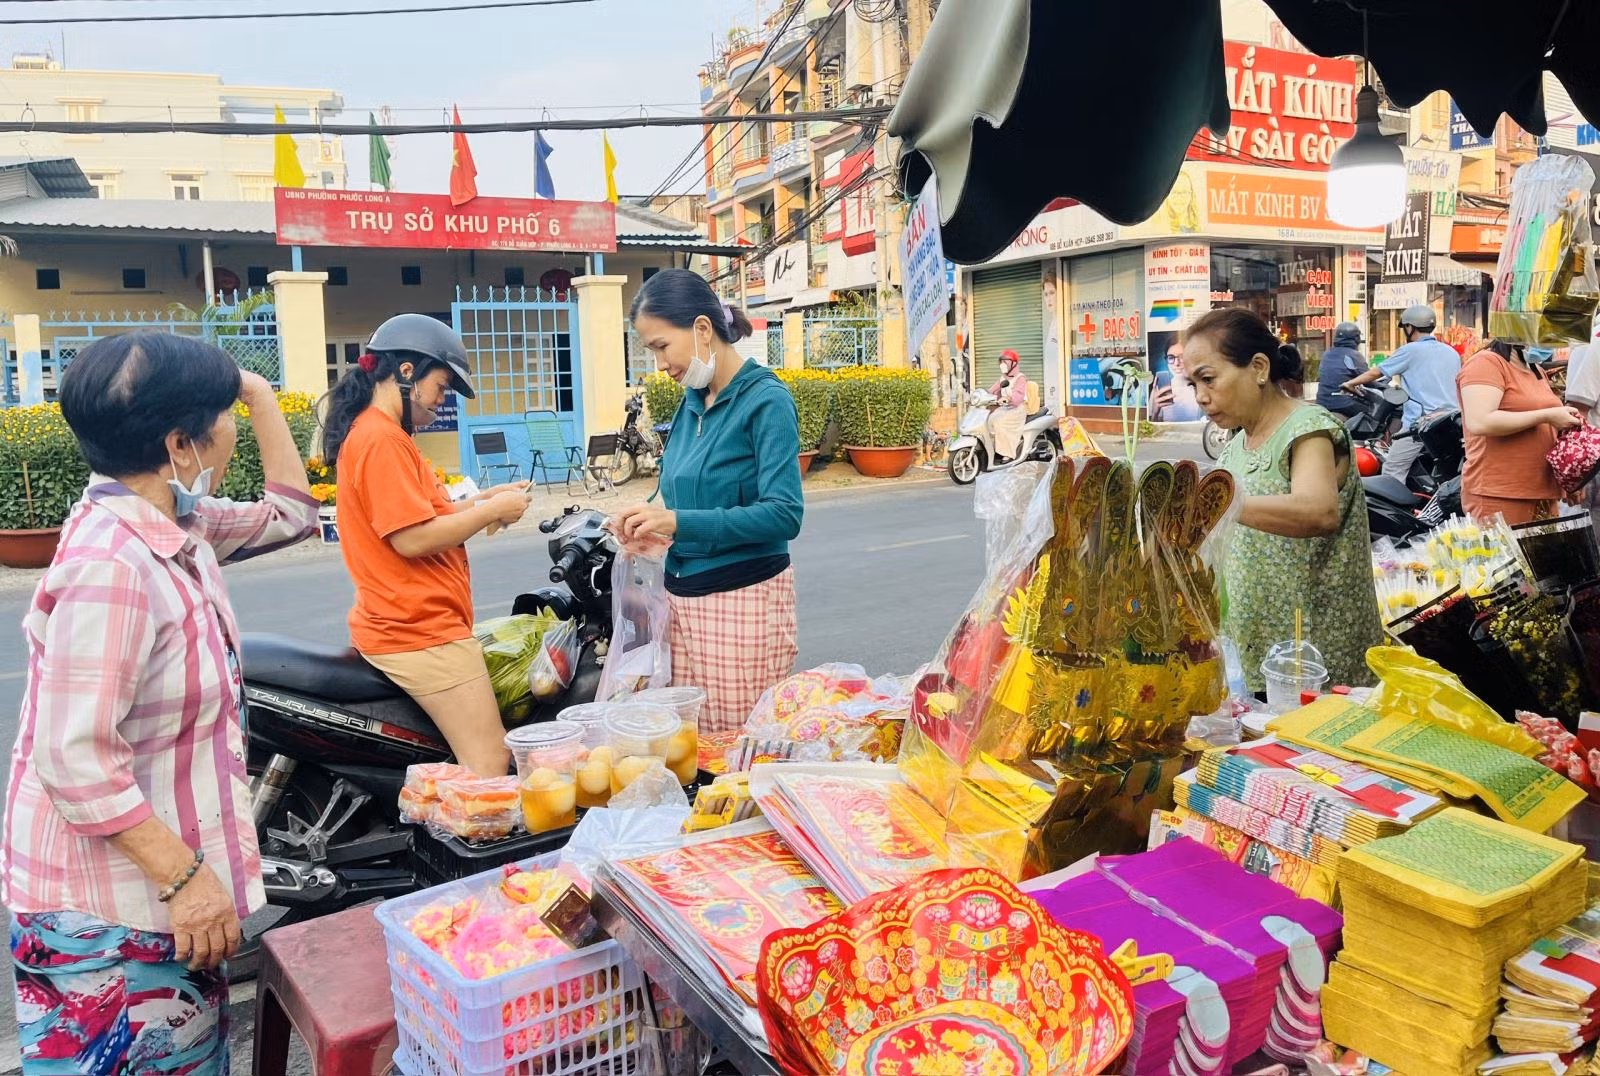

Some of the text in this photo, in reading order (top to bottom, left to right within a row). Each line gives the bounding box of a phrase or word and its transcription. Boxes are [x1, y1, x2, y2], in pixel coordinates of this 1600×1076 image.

[1282, 63, 1354, 124] KÍNH
[1251, 116, 1296, 162] SÀI
[1300, 123, 1350, 165] GÒ
[284, 191, 305, 199] UBND
[365, 194, 383, 203] LONG
[1210, 176, 1249, 216] MẮT
[1254, 184, 1295, 219] KÍNH
[1299, 195, 1321, 220] BV
[346, 206, 561, 236] TRỤ SỞ KHU PHỐ 6
[1384, 243, 1423, 276] KÍNH
